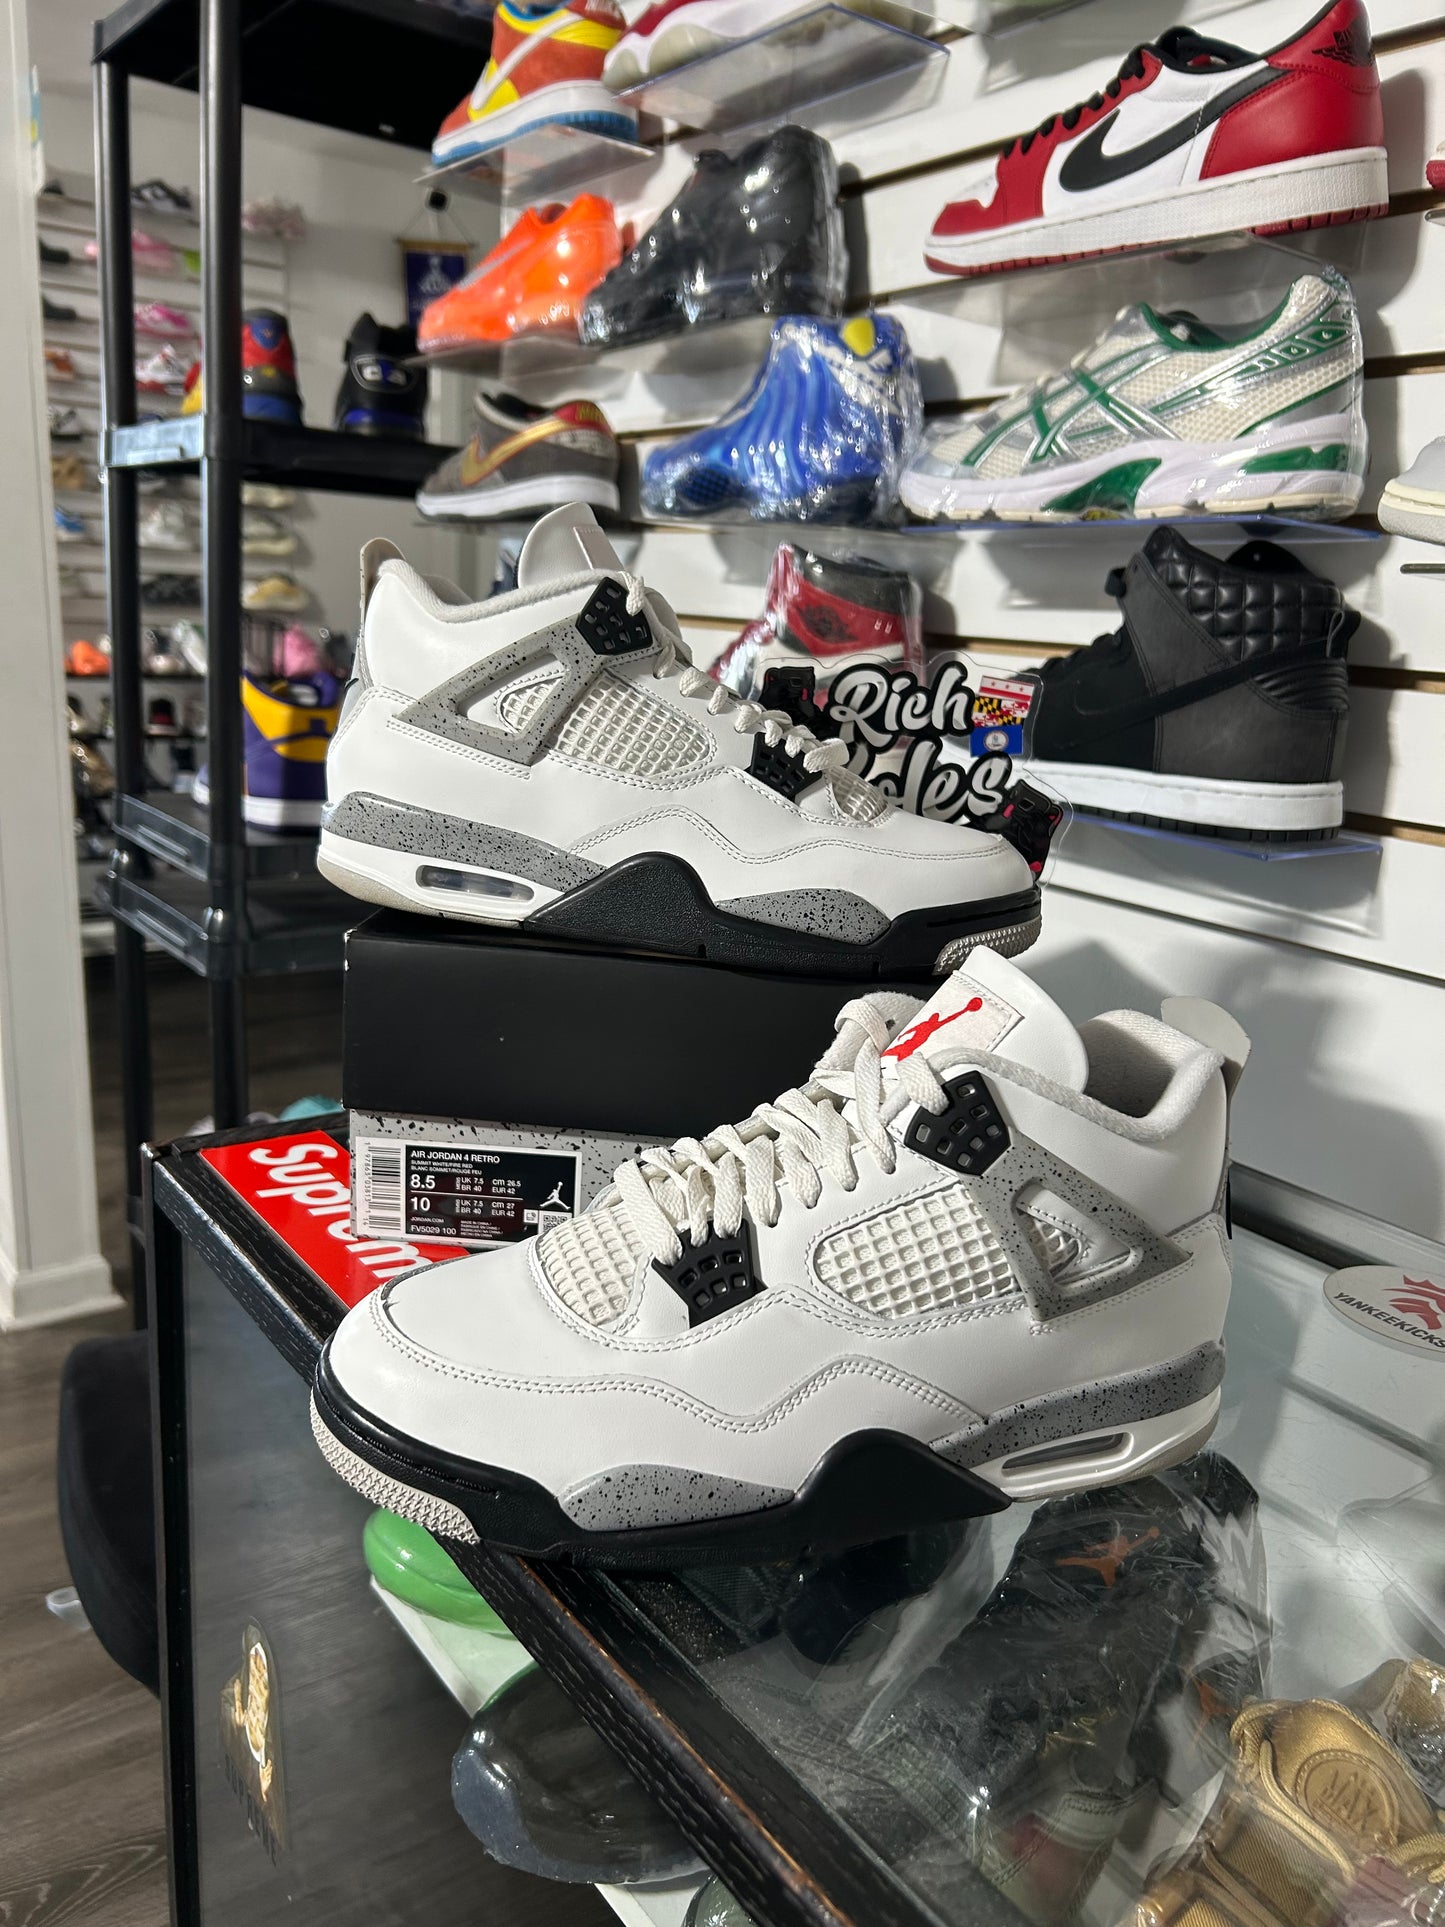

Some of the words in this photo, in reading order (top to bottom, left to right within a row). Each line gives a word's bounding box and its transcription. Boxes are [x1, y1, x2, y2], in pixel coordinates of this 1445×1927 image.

[829, 664, 969, 748] Rich
[848, 740, 1008, 824] les
[411, 1150, 426, 1159] AIR
[427, 1151, 462, 1161] JORDAN
[463, 1154, 470, 1162] 4
[471, 1154, 500, 1164] RETRO
[410, 1174, 436, 1190] 8.5
[411, 1196, 431, 1211] 10
[411, 1225, 440, 1234] FV5029
[442, 1227, 457, 1235] 100
[1333, 1292, 1445, 1348] YANKEEKICKS
